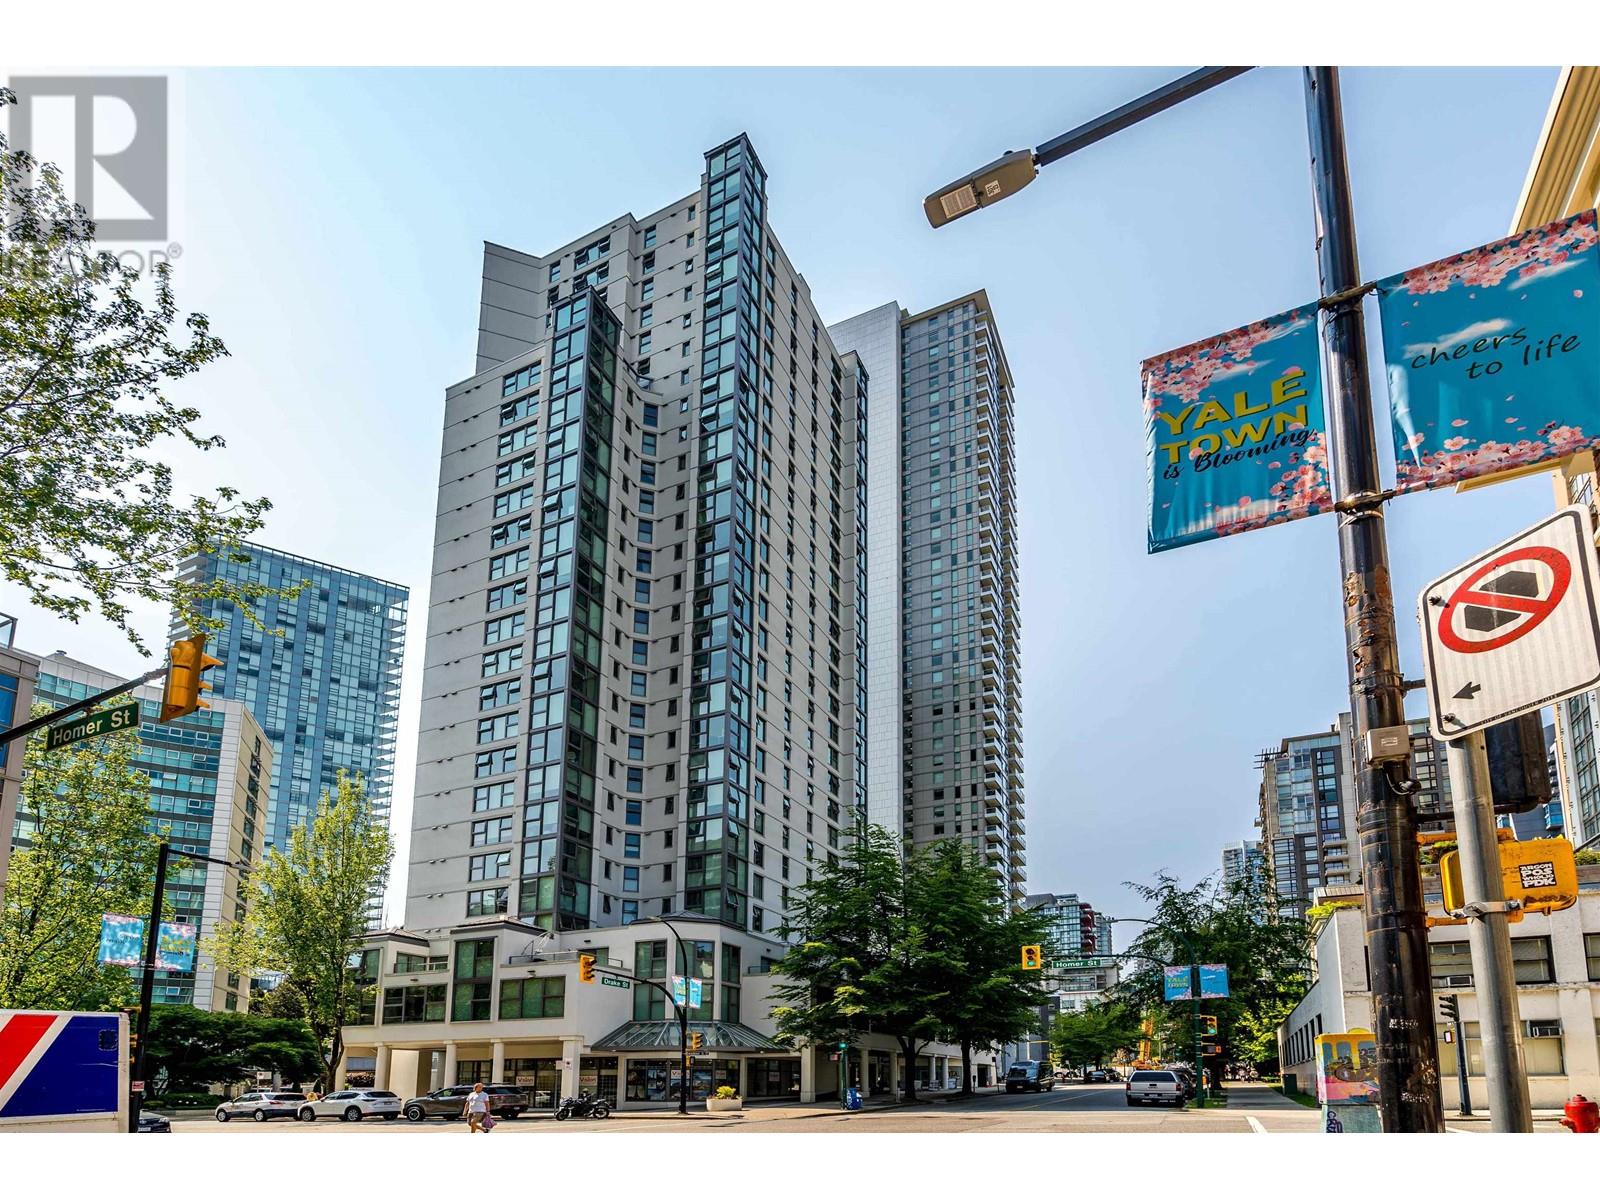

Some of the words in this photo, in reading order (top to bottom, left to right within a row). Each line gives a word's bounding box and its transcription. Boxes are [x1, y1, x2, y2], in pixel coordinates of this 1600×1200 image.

[1411, 327, 1527, 369] cheers
[1466, 361, 1503, 380] to
[1523, 333, 1581, 366] life
[1157, 369, 1307, 436] YALE
[1160, 404, 1309, 465] TOWN
[1163, 463, 1184, 480] is
[1194, 428, 1315, 473] Blooming
[53, 719, 103, 745] Homer
[110, 709, 131, 728] St
